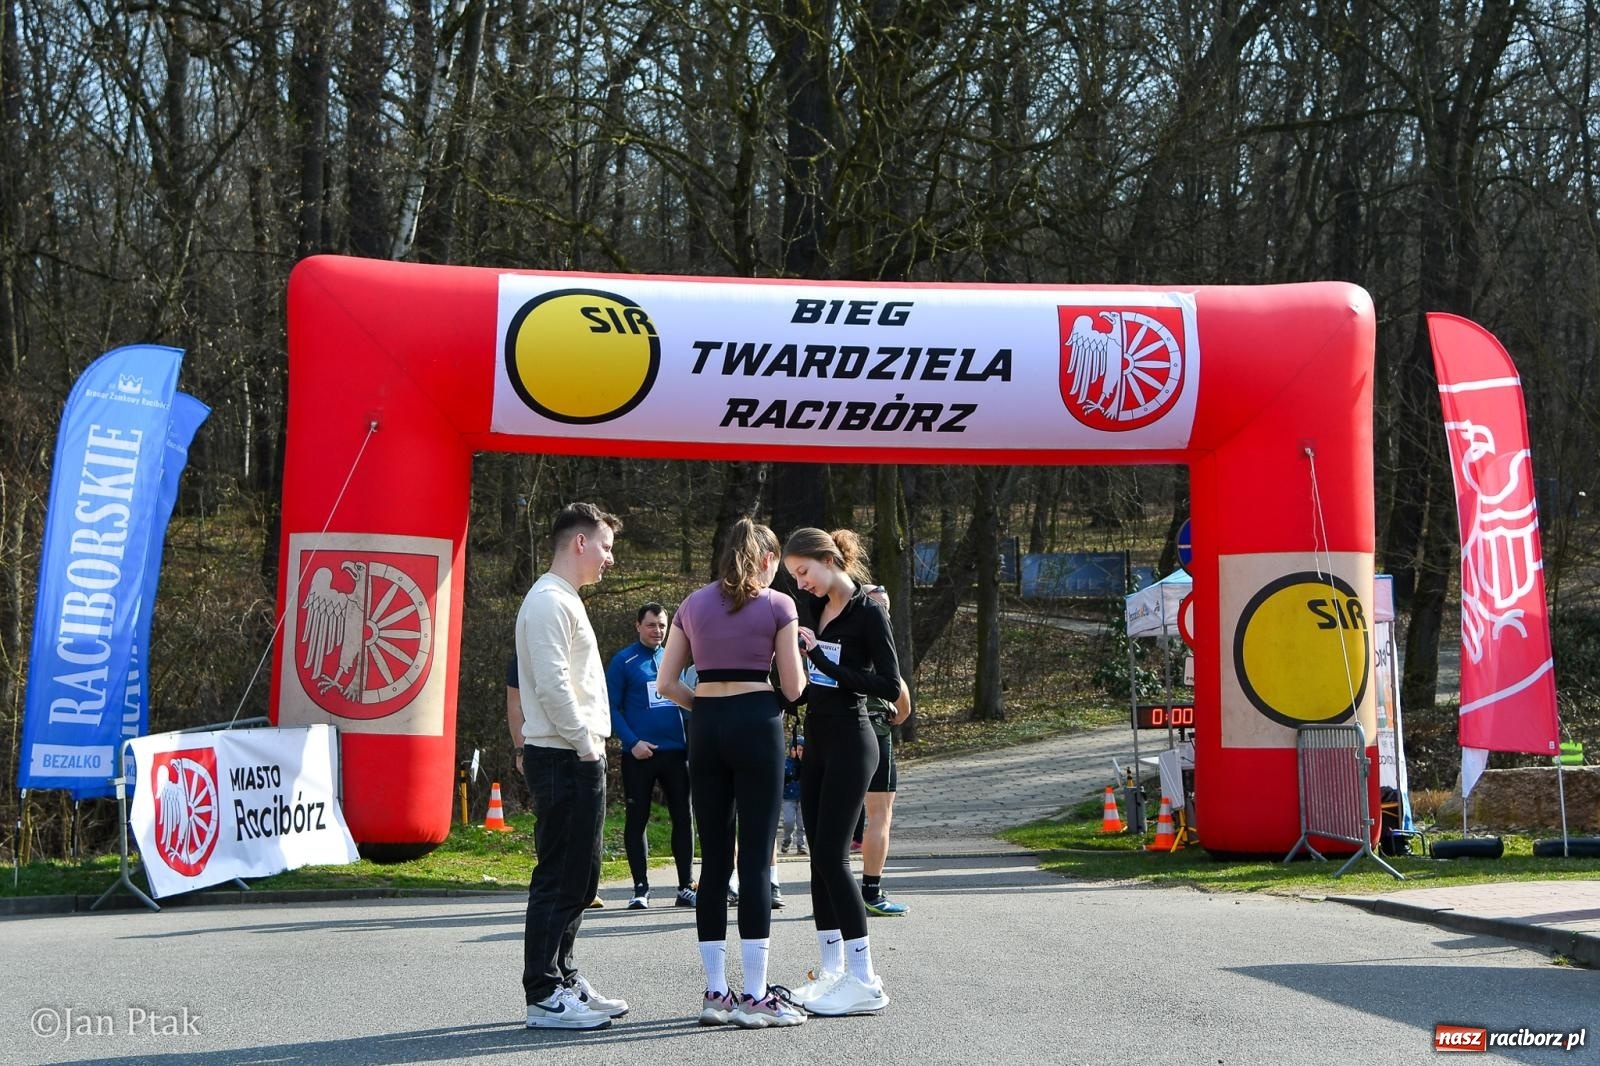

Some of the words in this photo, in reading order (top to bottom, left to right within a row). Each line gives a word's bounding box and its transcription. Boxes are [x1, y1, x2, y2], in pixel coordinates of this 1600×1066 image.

[580, 306, 657, 335] SIR
[790, 298, 914, 326] BIEG
[691, 341, 1012, 382] TWARDZIELA
[719, 393, 978, 432] RACIBÓRZ
[48, 423, 143, 727] RACIBORSKIE
[1307, 598, 1367, 630] SIR
[42, 753, 101, 769] BEZALKO
[229, 764, 281, 792] MIASTO
[233, 791, 326, 841] Racibórz
